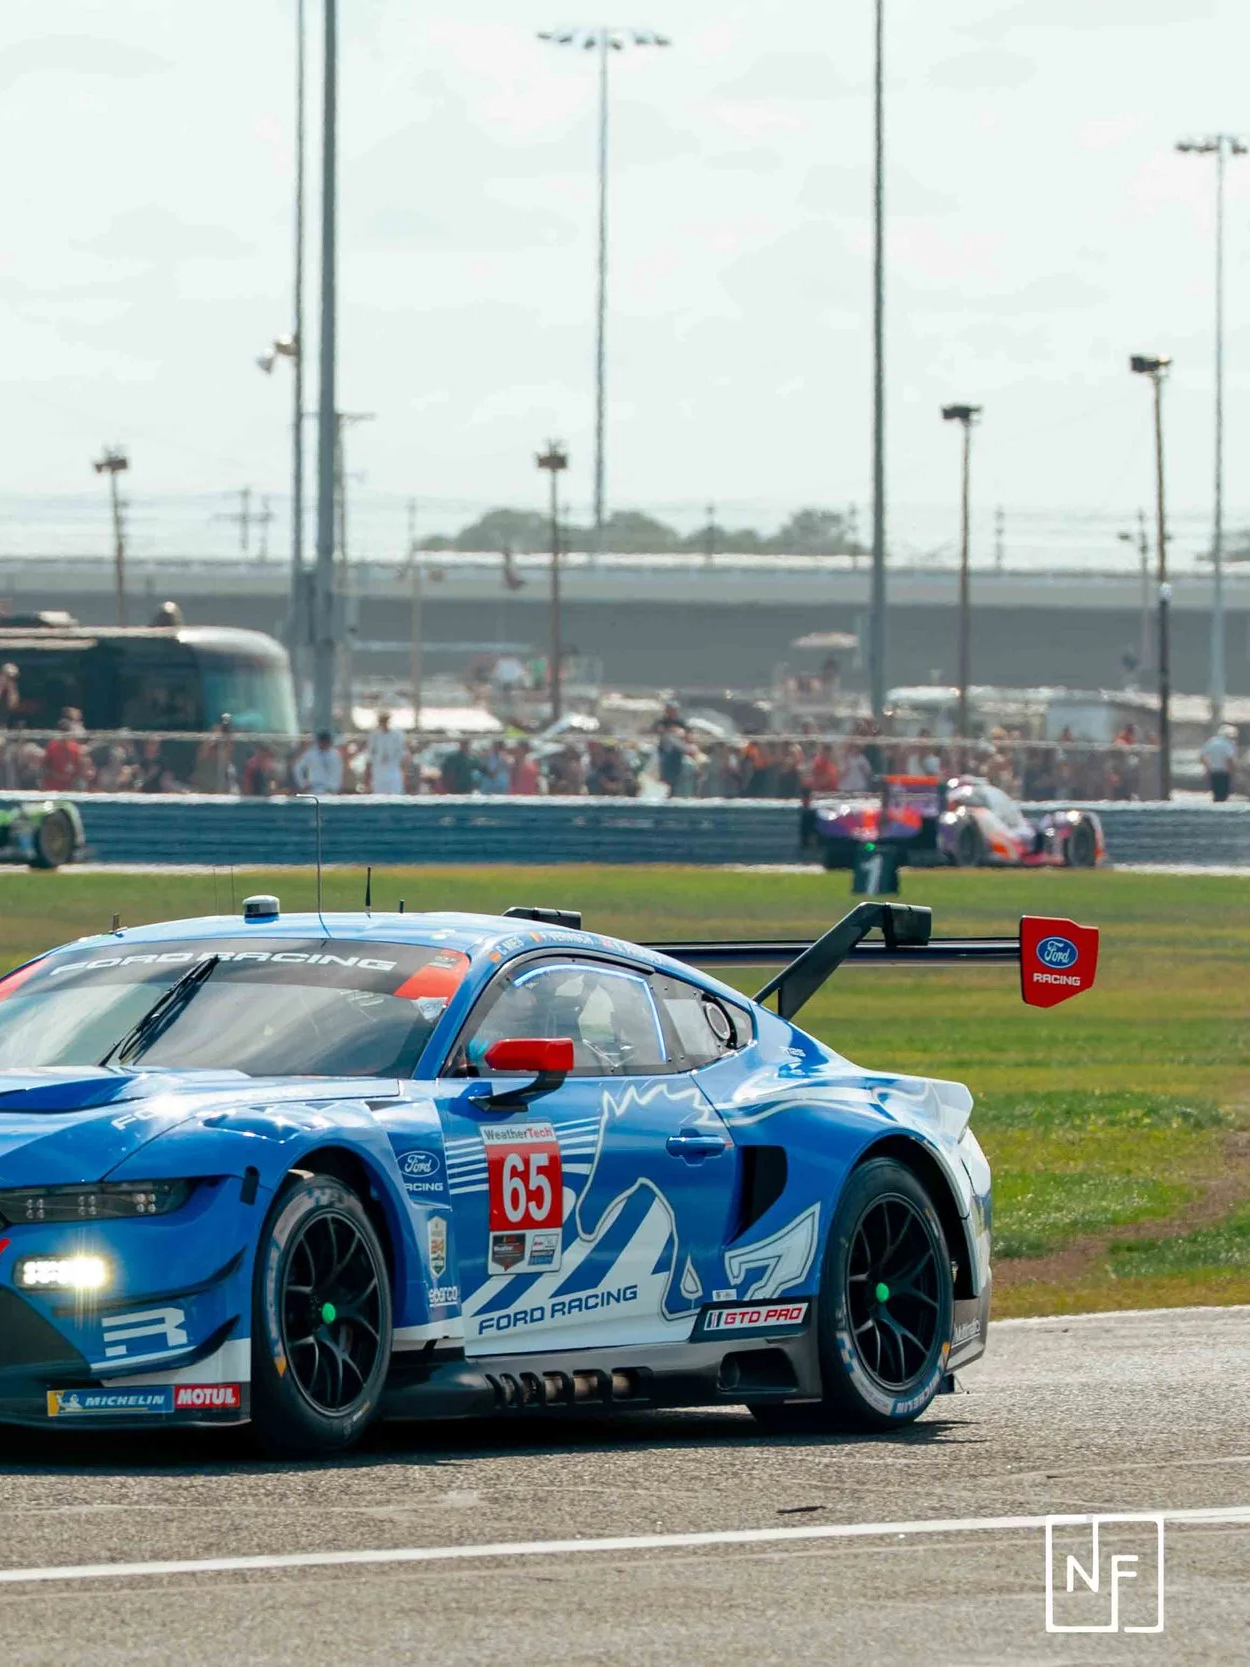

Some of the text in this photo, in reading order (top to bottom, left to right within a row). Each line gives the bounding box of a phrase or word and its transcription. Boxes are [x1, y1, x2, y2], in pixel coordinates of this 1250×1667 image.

[861, 854, 883, 896] 1
[50, 952, 397, 976] FORD RACING
[1033, 973, 1081, 986] RACING
[483, 1127, 554, 1141] WeatherTech
[403, 1182, 444, 1192] ACING
[502, 1152, 552, 1223] 65
[428, 1285, 458, 1304] sparco
[478, 1284, 638, 1335] FORD RACING
[724, 1308, 802, 1325] GTD PRO
[85, 1387, 236, 1406] MICHELIN MOTUL
